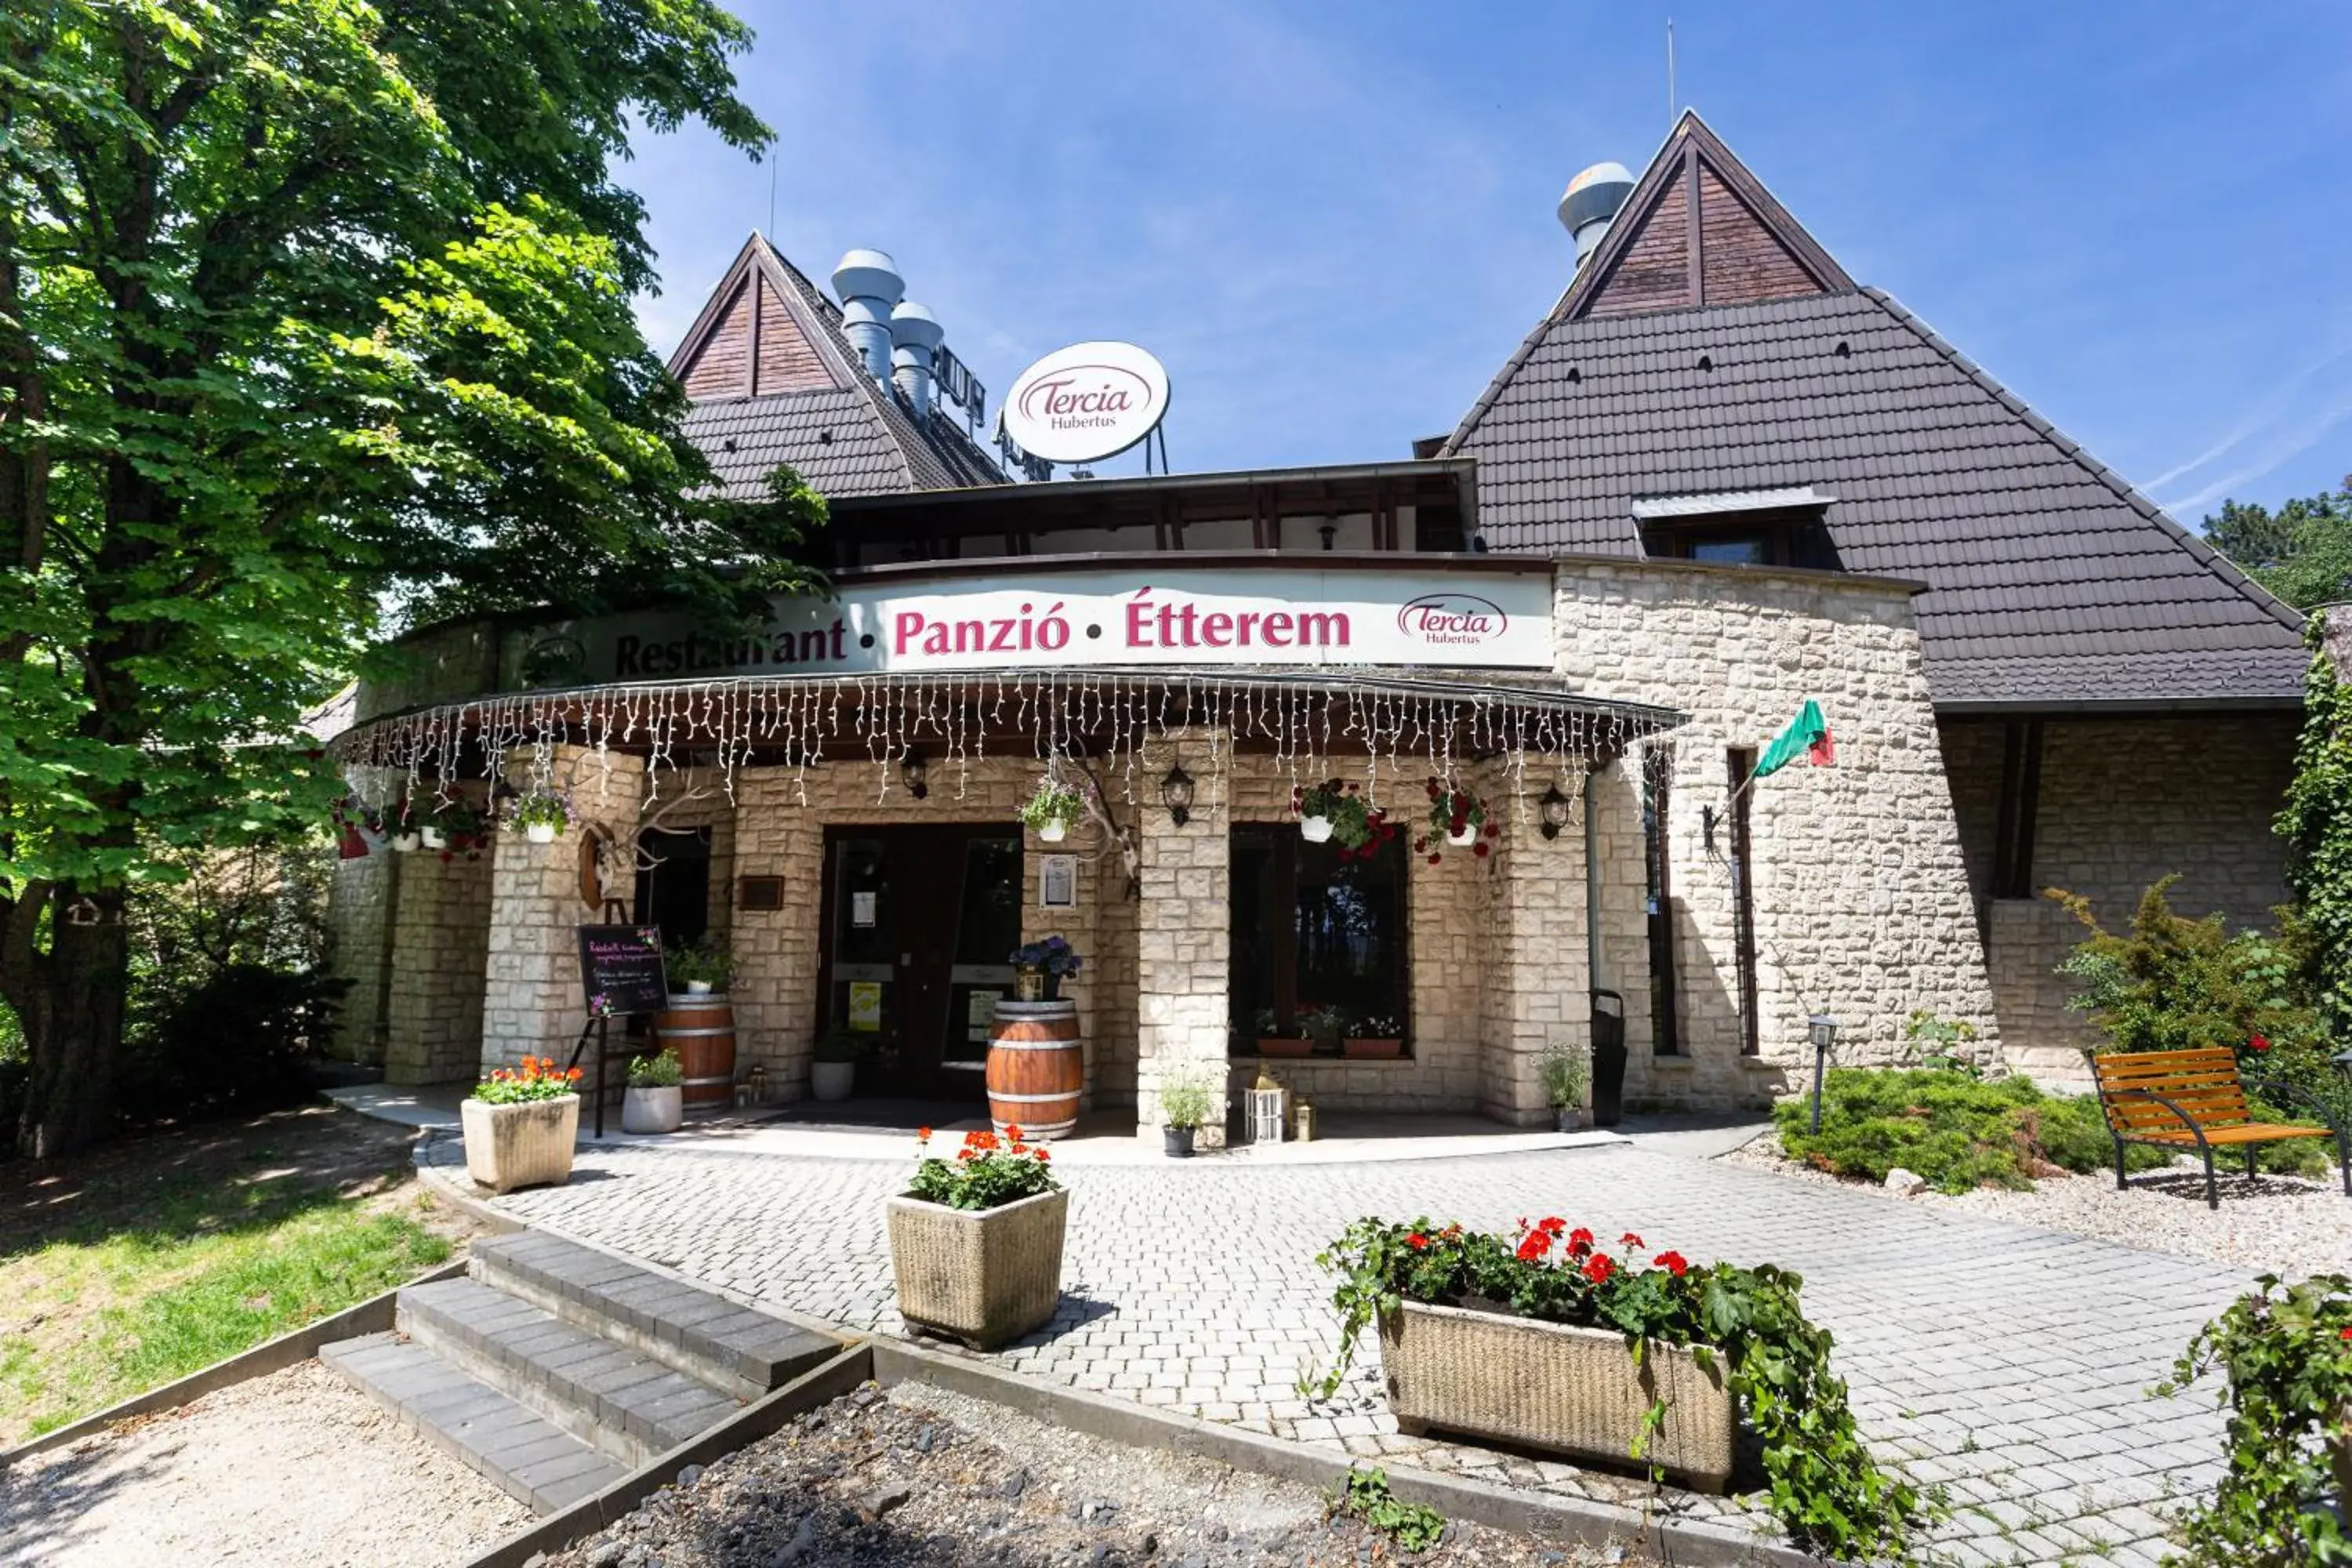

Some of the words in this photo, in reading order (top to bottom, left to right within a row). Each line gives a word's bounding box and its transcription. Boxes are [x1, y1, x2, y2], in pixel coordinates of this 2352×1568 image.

[1033, 379, 1132, 415] Tercia
[1051, 416, 1116, 430] Hubertus
[617, 618, 848, 677] Restaurant
[894, 601, 1070, 655] Panzió
[1126, 585, 1350, 648] Étterem
[1410, 603, 1492, 633] Tercia
[1426, 632, 1481, 644] Hubertus
